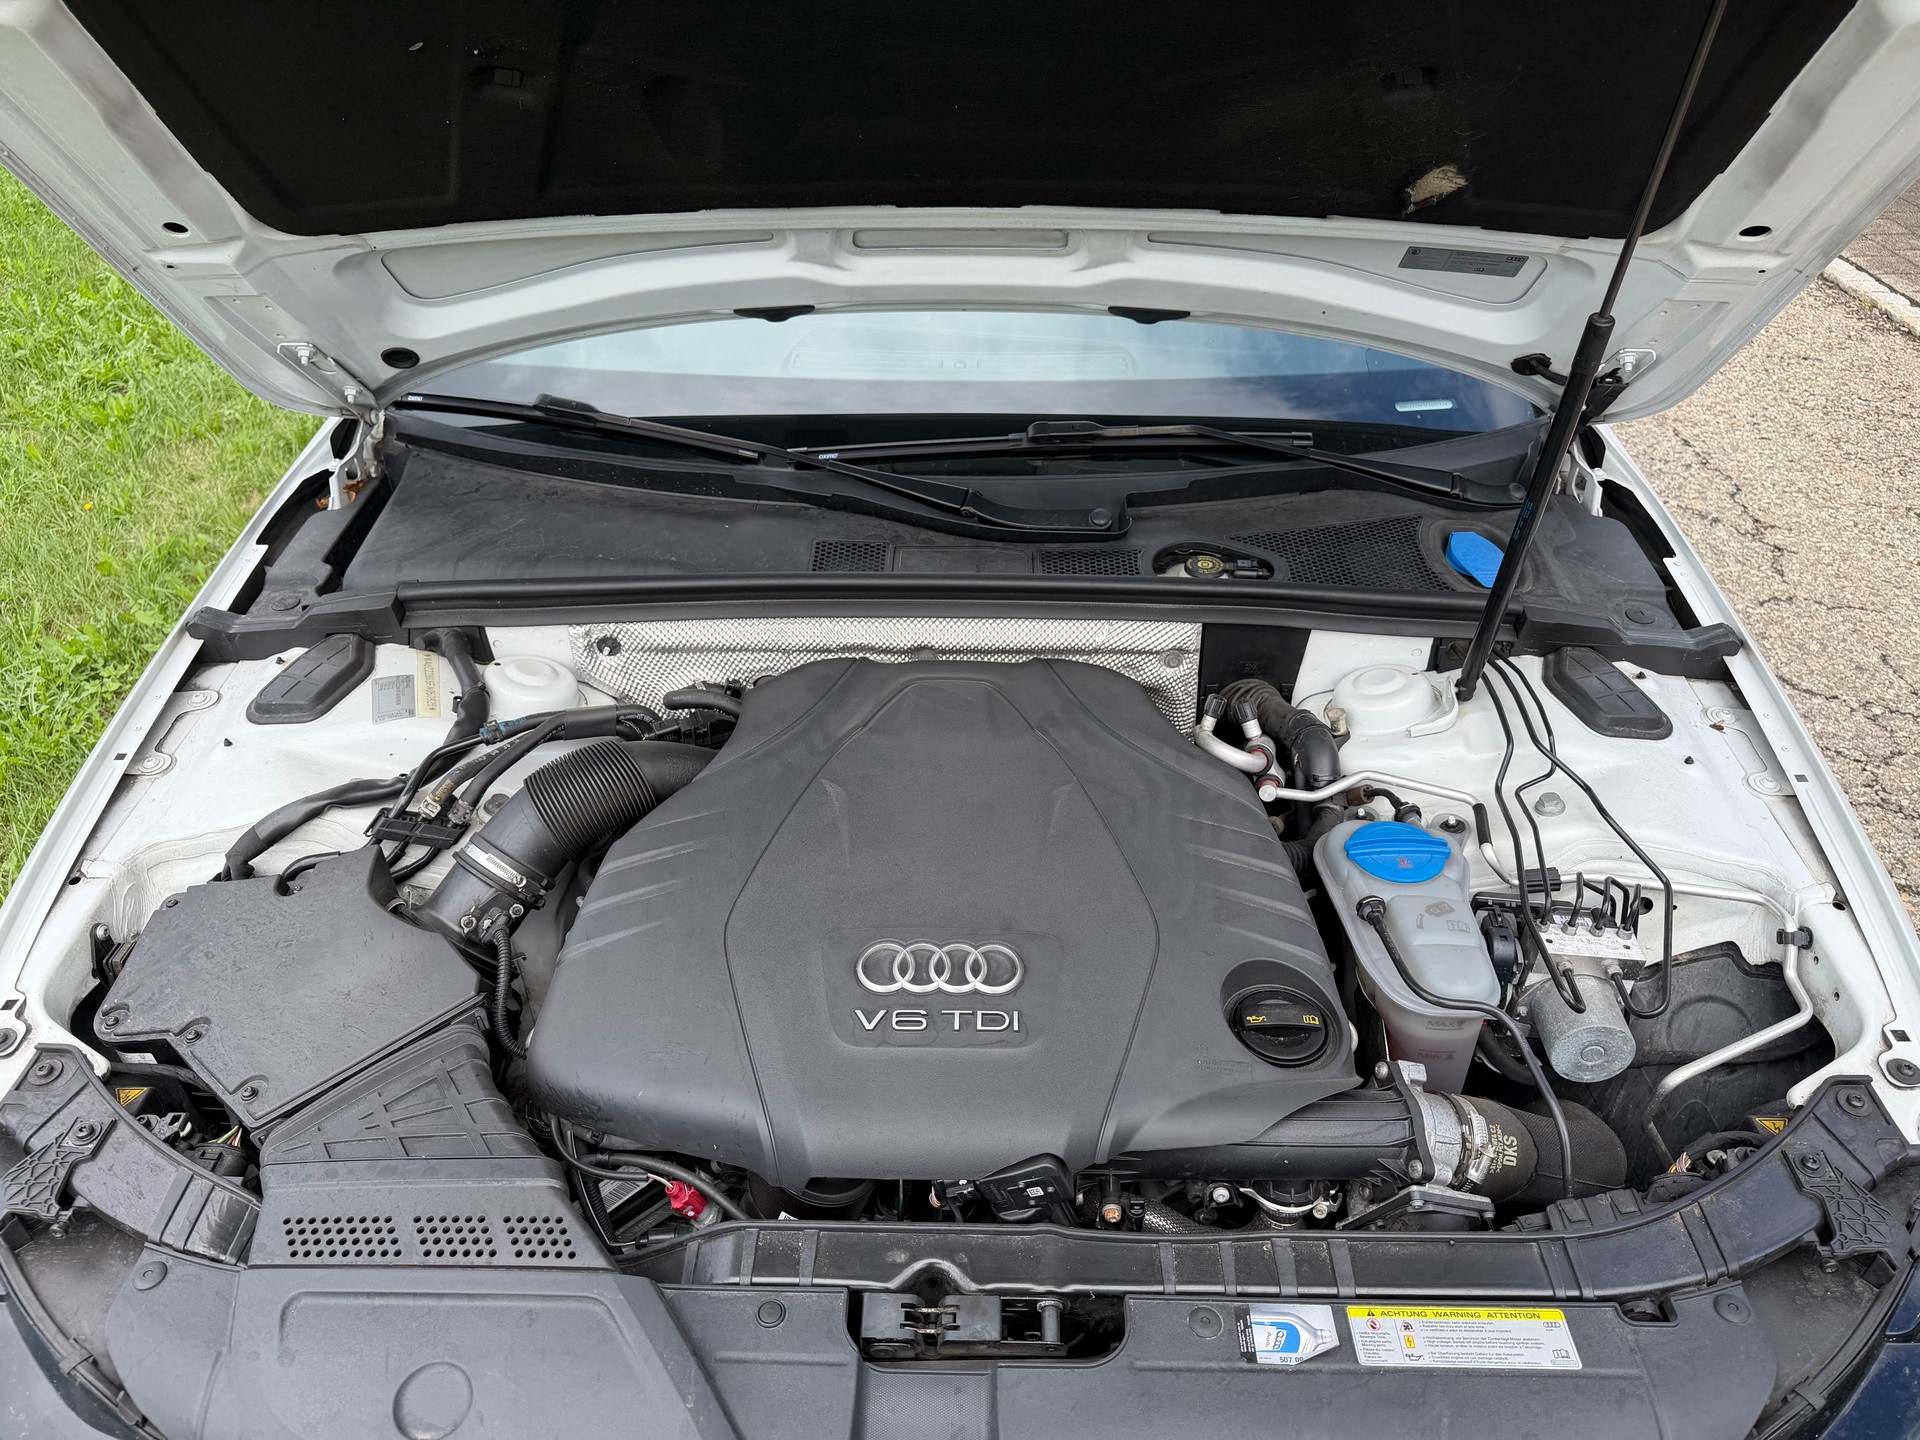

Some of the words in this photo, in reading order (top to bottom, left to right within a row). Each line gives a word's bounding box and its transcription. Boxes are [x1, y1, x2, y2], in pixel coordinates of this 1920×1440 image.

[854, 1010, 928, 1030] V6
[941, 1010, 1018, 1031] TDI
[1503, 1135, 1518, 1166] DKS
